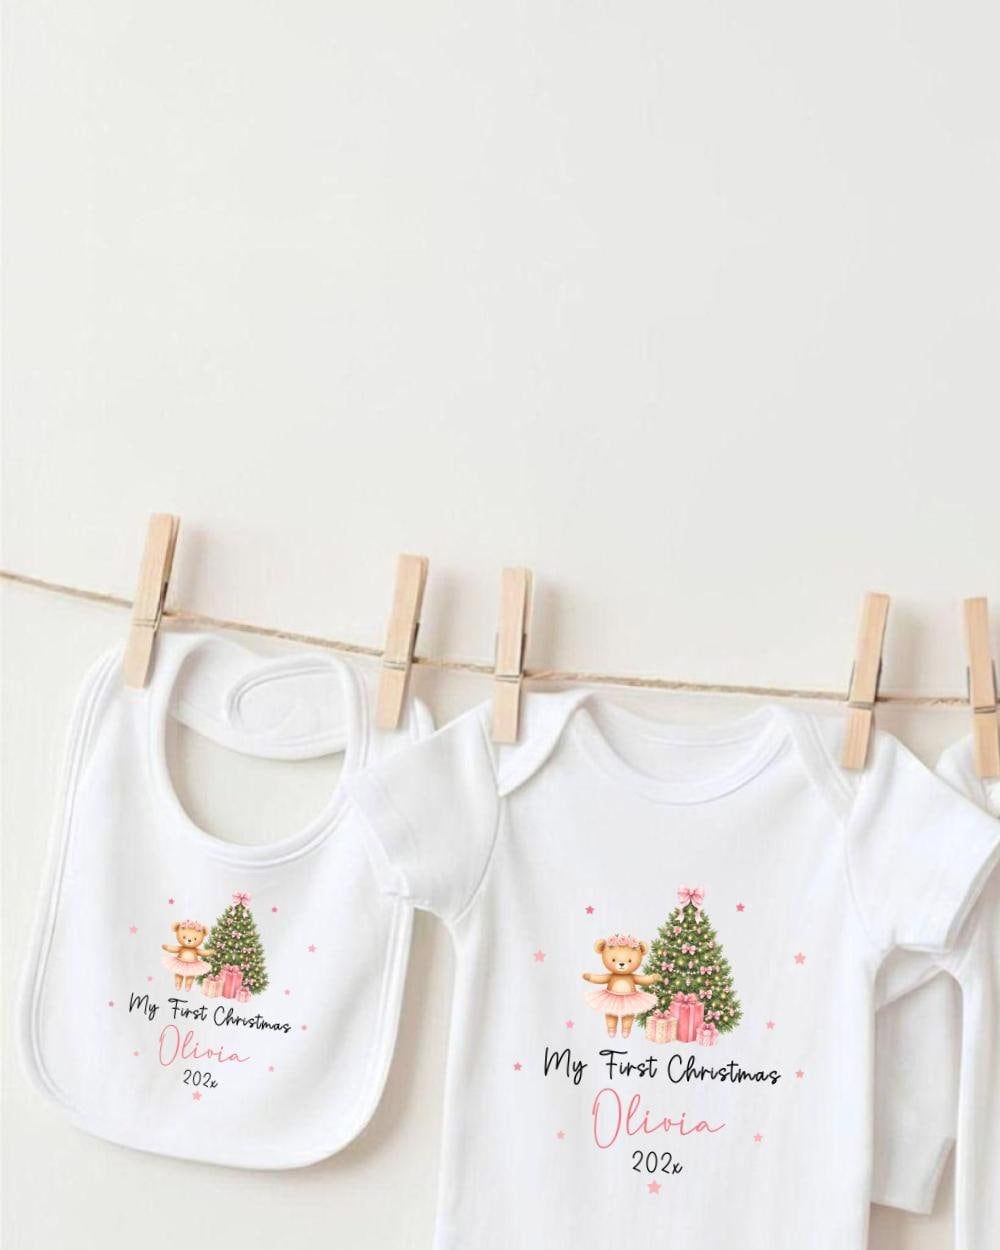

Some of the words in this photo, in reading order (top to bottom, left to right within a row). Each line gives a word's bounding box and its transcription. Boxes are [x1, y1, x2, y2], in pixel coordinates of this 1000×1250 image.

[128, 992, 160, 1021] My
[167, 997, 209, 1022] First
[213, 1005, 292, 1034] Christmas
[159, 1024, 250, 1067] Olivia
[543, 1046, 588, 1086] My
[599, 1049, 658, 1080] First
[667, 1053, 782, 1085] Christmas
[183, 1069, 219, 1089] 202x
[592, 1088, 726, 1149] Olivia
[632, 1150, 684, 1175] 202x
